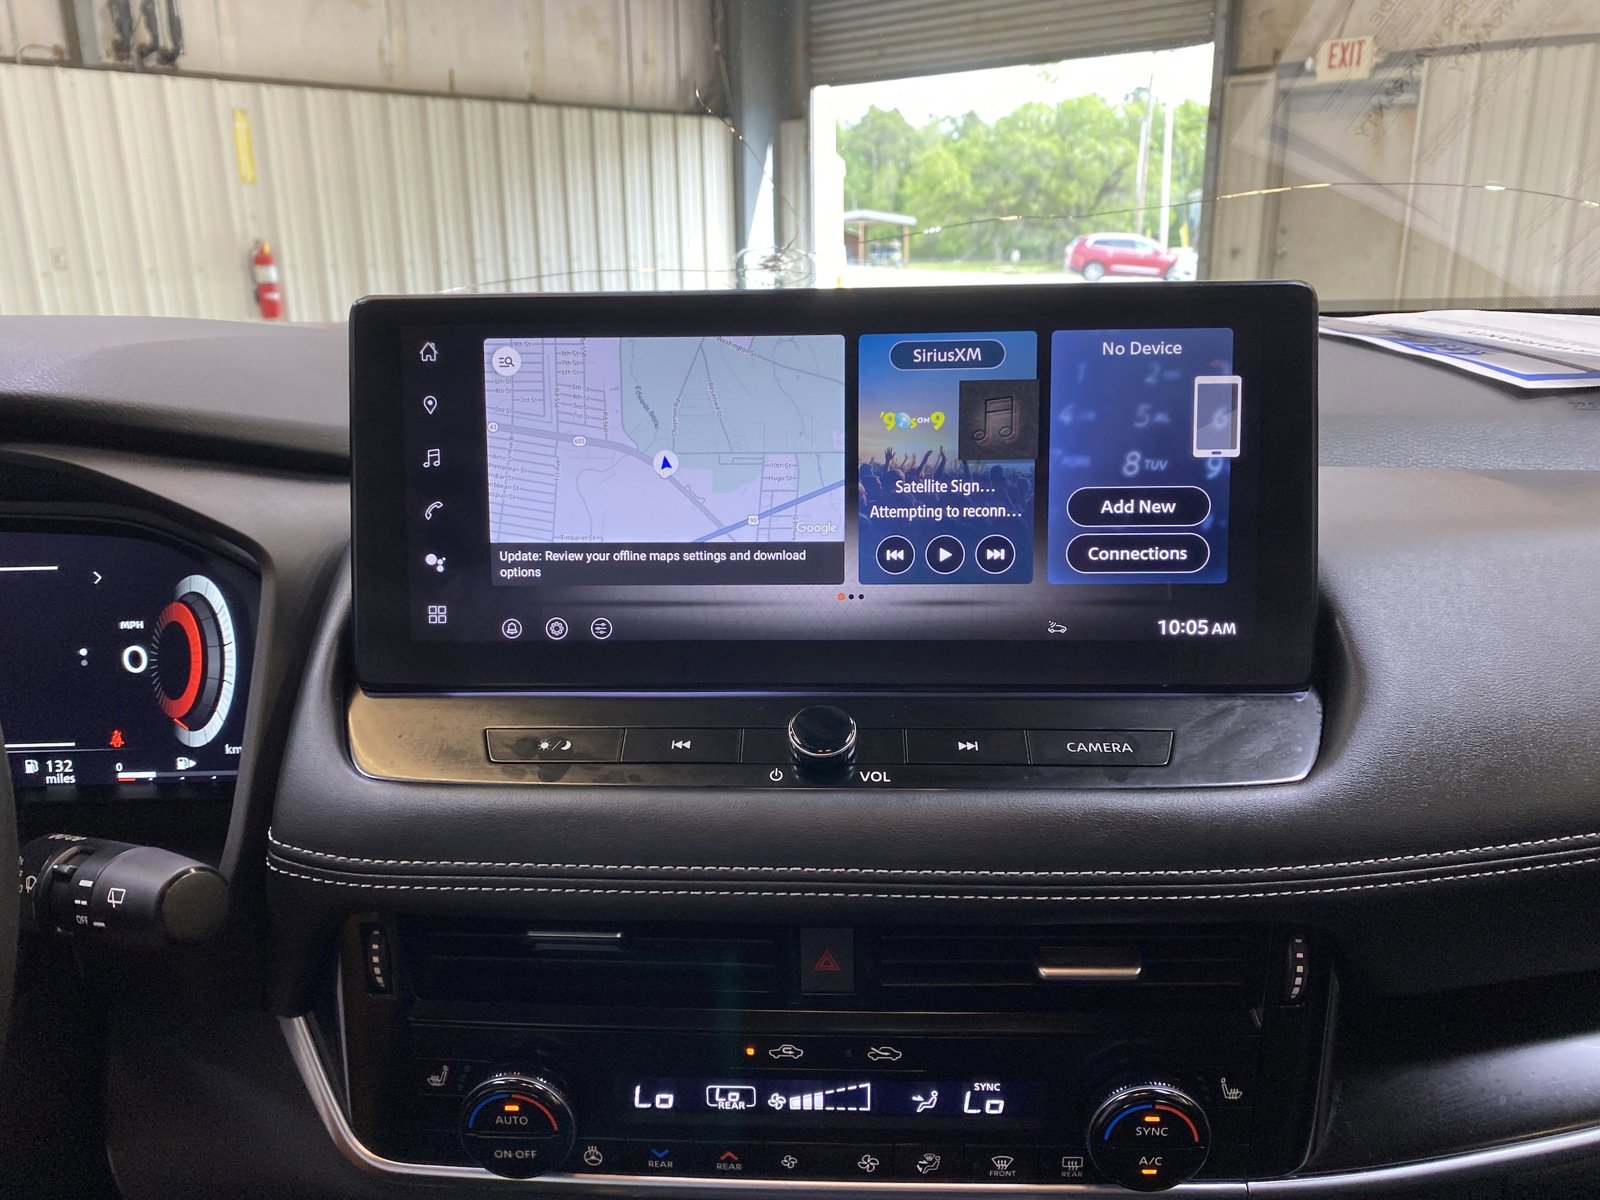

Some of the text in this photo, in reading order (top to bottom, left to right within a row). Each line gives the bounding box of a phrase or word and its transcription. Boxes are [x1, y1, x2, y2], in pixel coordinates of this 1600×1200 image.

[1327, 39, 1366, 70] EXIT
[1102, 341, 1182, 355] No Device
[913, 348, 982, 363] SiriusXM
[635, 385, 660, 429] Edwards Bayou
[917, 416, 930, 424] ON
[930, 411, 946, 431] 9
[1122, 451, 1169, 477] 8 TUV
[1205, 457, 1223, 480] 9
[768, 475, 784, 483] Hugo
[896, 479, 948, 493] Satellite
[870, 504, 943, 521] Attempting
[946, 505, 960, 518] to
[1100, 499, 1176, 514] Add New
[796, 521, 838, 536] Google
[499, 550, 807, 563] Update: Review your offline maps settings and download
[1088, 547, 1188, 560] Connections
[500, 567, 542, 579] options
[119, 620, 144, 630] MPH
[1158, 619, 1237, 635] 10:05 AM
[122, 645, 148, 674] 0
[1066, 741, 1134, 754] CAMERA
[46, 760, 73, 773] 132
[115, 762, 123, 772] 0
[45, 775, 76, 785] miles
[859, 771, 891, 783] VOL
[75, 915, 89, 926] OFF
[974, 1082, 1001, 1092] SYNC
[635, 1085, 674, 1109] Lo
[715, 1087, 740, 1102] Lo
[718, 1100, 746, 1110] REAR
[963, 1091, 1005, 1114] Lo
[495, 1116, 528, 1125] AUTO
[1136, 1126, 1169, 1137] SYNC
[648, 1160, 673, 1169] REAR
[716, 1162, 742, 1170] REAR
[1138, 1156, 1163, 1166] A/C
